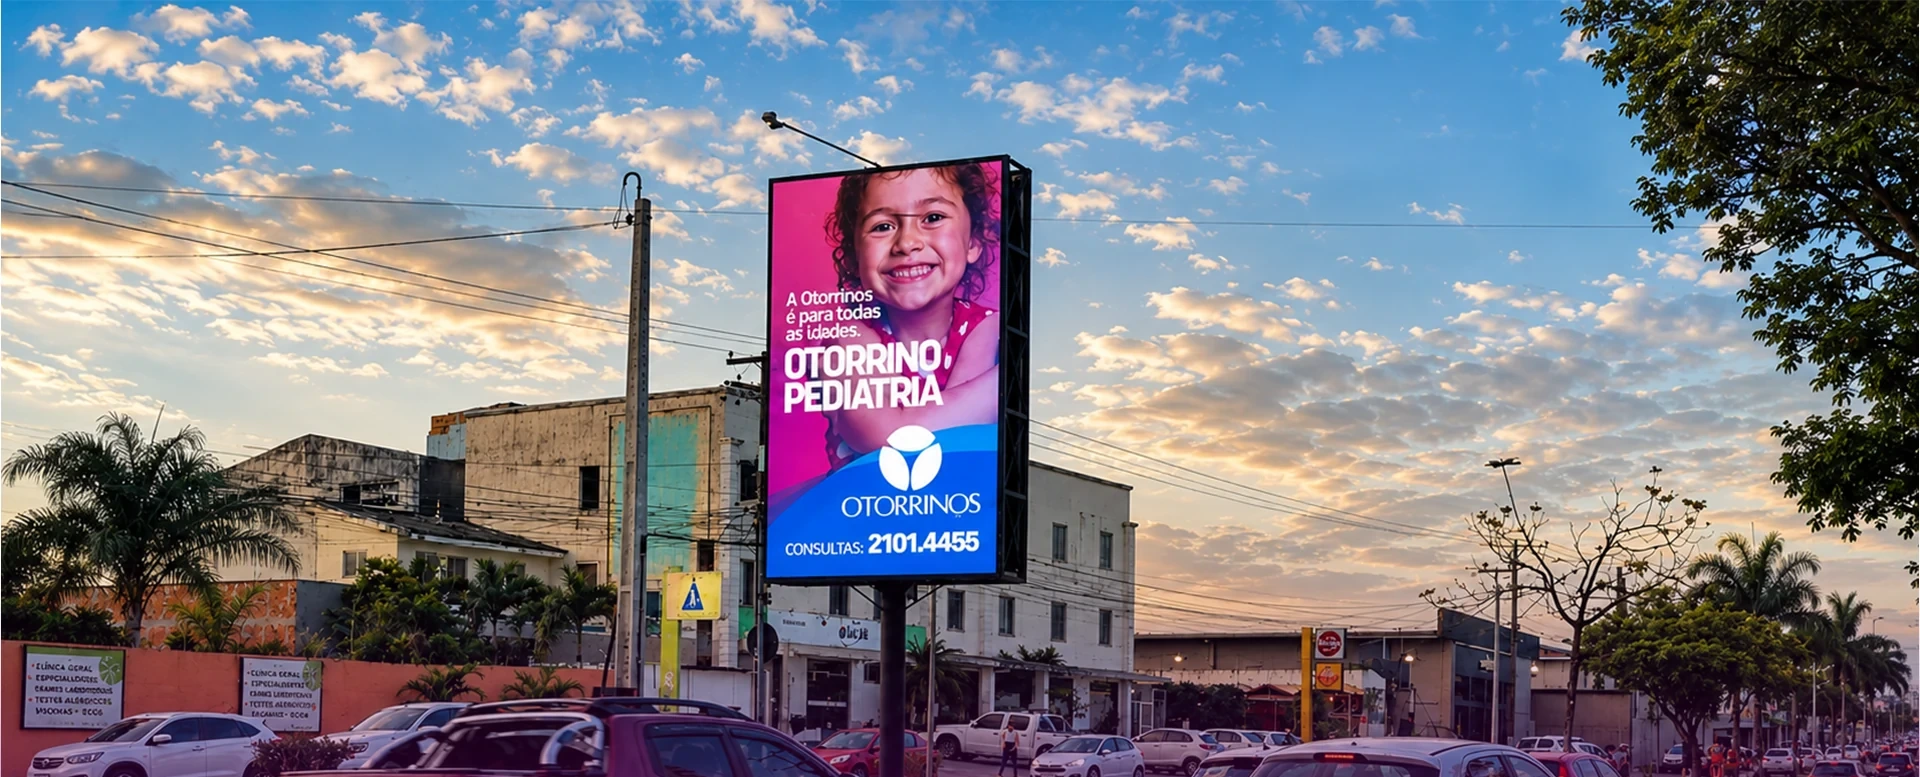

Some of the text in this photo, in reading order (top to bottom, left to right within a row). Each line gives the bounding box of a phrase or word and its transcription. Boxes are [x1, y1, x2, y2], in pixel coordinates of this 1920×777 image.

[786, 289, 873, 307] A Otorrinos
[786, 304, 881, 328] é para todas
[785, 324, 861, 341] as idades.
[784, 374, 944, 413] PEDIATRIA
[841, 493, 982, 518] OTORRINOS
[785, 531, 980, 556] CONSULTAS: 2101.4455
